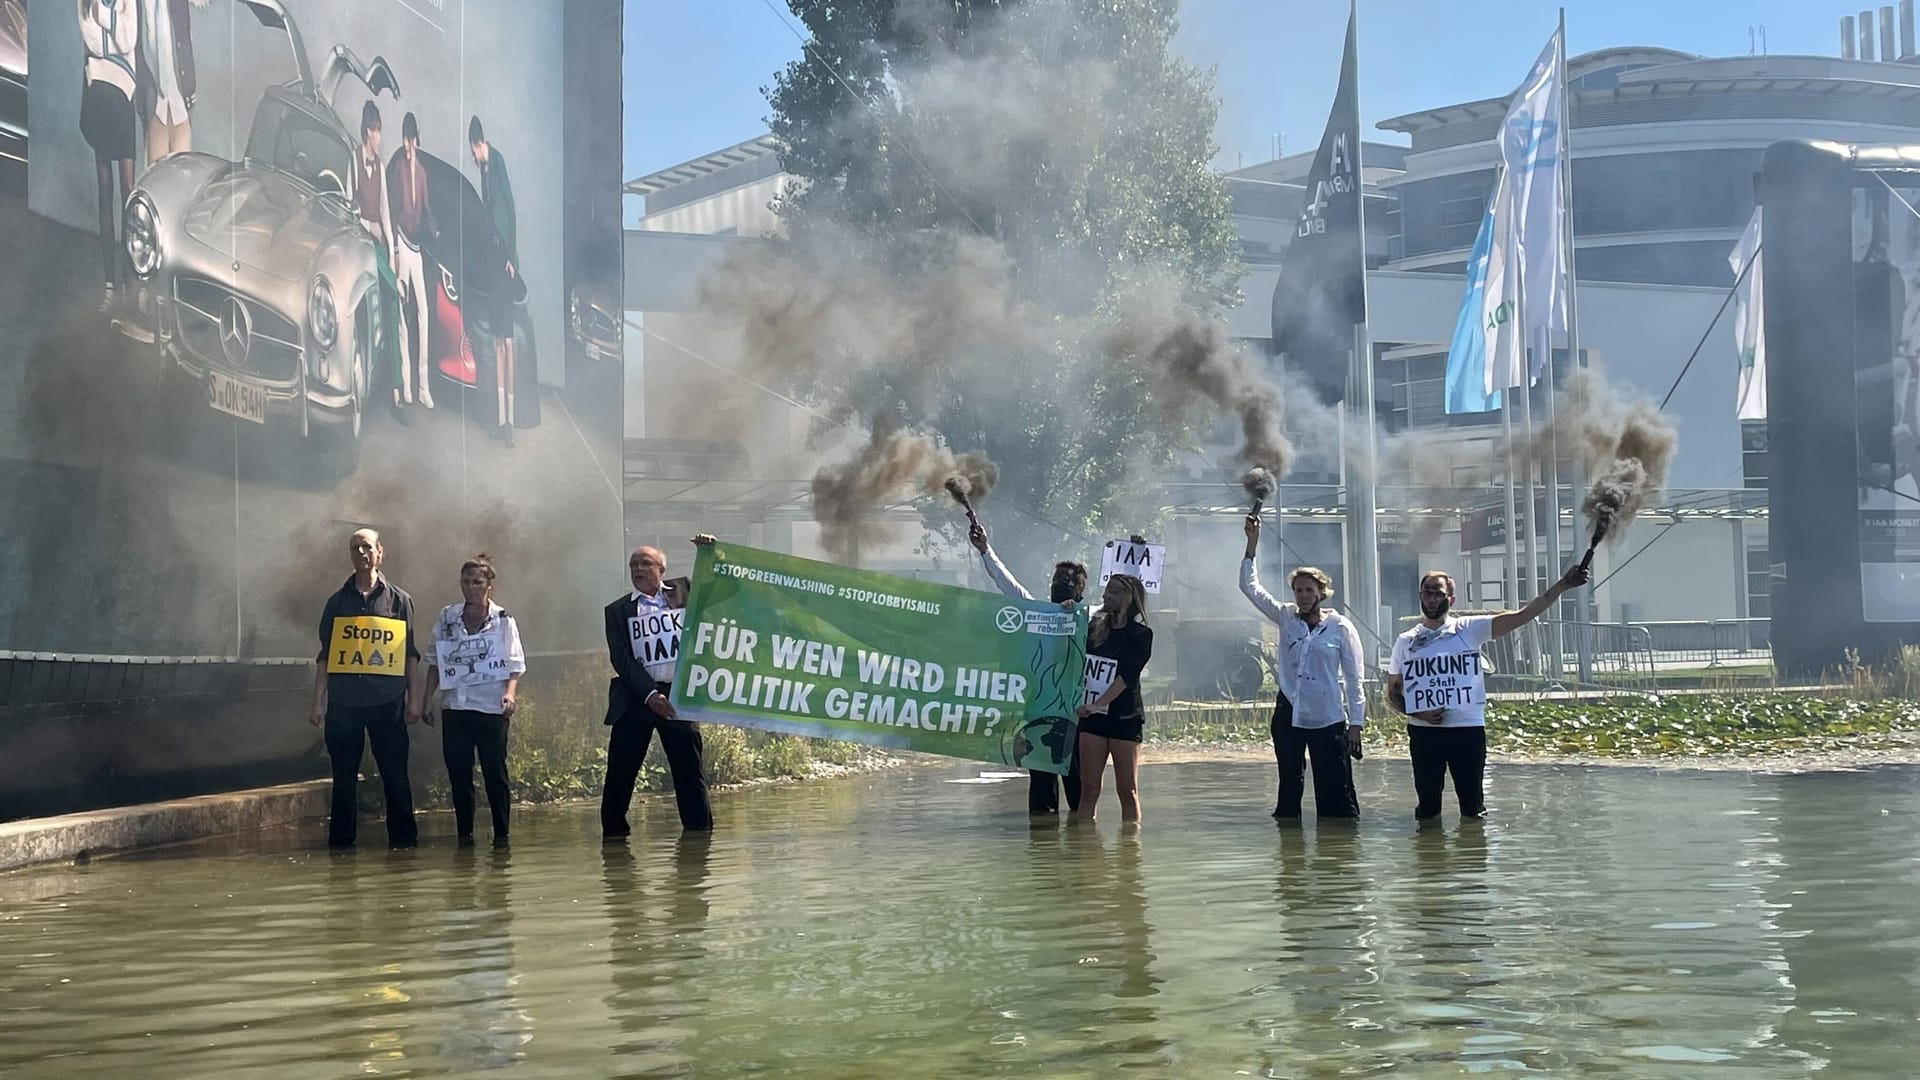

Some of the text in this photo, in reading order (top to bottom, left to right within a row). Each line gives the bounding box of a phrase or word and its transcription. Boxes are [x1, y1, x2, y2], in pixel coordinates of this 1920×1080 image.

[1115, 545, 1151, 567] IAA
[713, 562, 941, 616] #STOPGREENWASHING #STOPLOBBYISMUS
[342, 624, 394, 645] Stopp
[632, 612, 684, 640] BLOCK
[694, 617, 1027, 704] FÜR WEN WIRD HIER
[1403, 653, 1480, 681] ZUKUNFT
[686, 664, 1001, 737] POLITIK GEMACHT?
[1415, 686, 1473, 710] PROFIT
